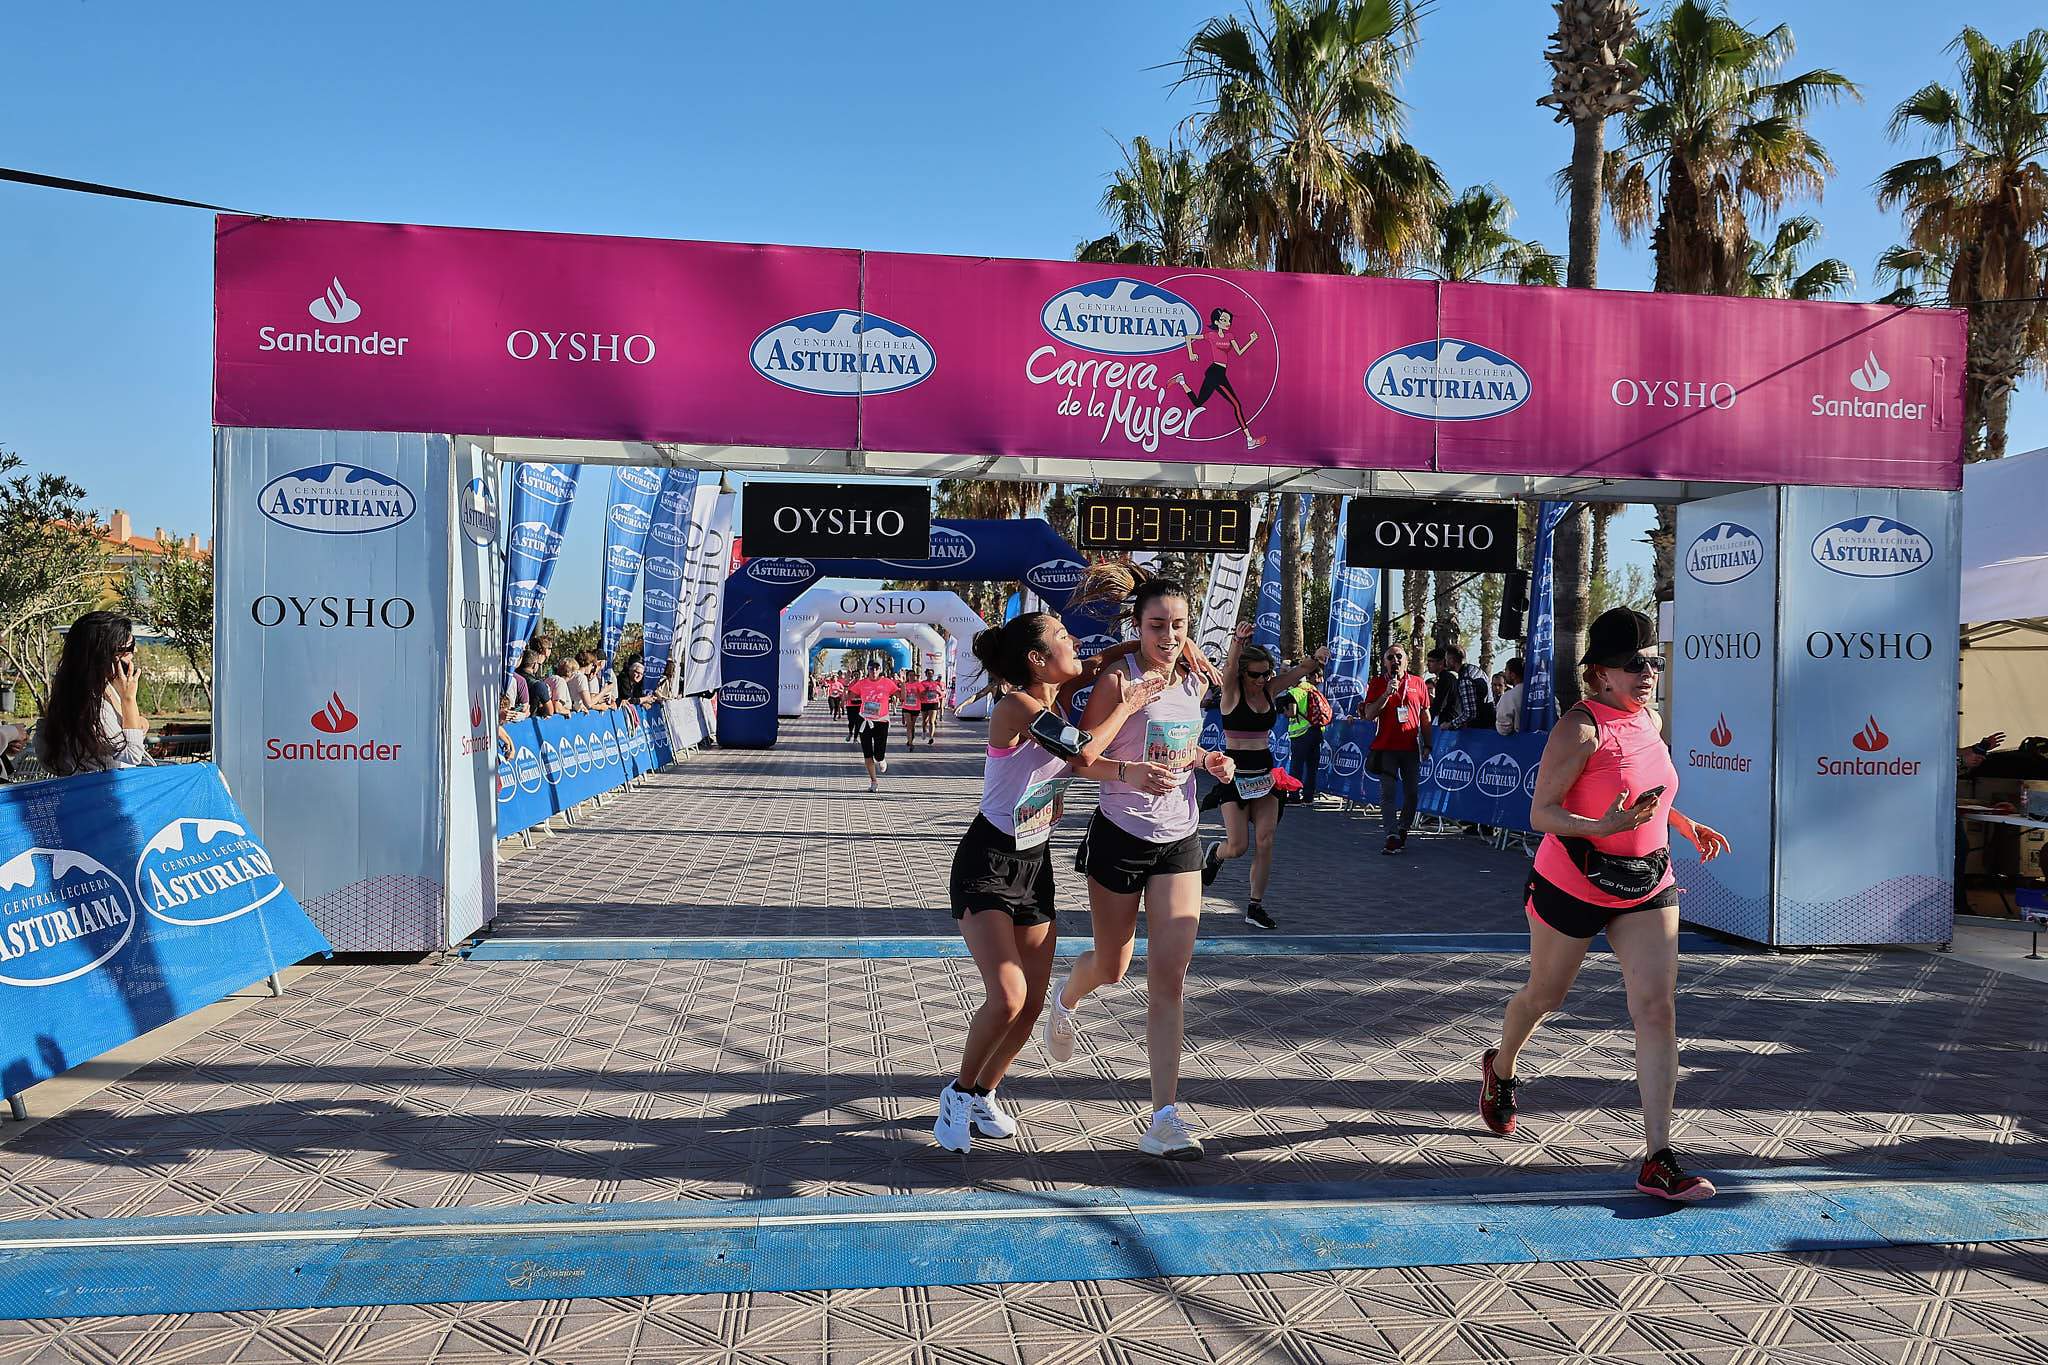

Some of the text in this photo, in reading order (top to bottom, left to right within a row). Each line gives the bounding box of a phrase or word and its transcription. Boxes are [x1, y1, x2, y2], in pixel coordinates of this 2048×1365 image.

[1053, 303, 1189, 338] ASTURIANA
[1078, 302, 1186, 315] CENTRAL LECHERA
[258, 326, 409, 357] Santander
[506, 329, 657, 364] OYSHO
[793, 337, 851, 349] CENTRAL
[764, 338, 922, 375] ASTURIANA
[1025, 345, 1166, 391] Carrera
[1377, 366, 1518, 401] ASTURIANA
[1403, 365, 1514, 377] CENTRAL LECHERA
[1610, 378, 1737, 410] OYSHO
[1811, 394, 1927, 420] Santander
[1057, 388, 1207, 453] de la Mujer
[293, 486, 400, 497] CENTRAL LECHERA
[519, 468, 574, 499] ASTURIANA
[269, 487, 405, 518] ASTURIANA
[773, 506, 905, 537] OYSHO
[1089, 505, 1238, 544] 00:37:12
[1374, 520, 1494, 550] OYSHO
[1819, 538, 1924, 564] ASTURIANA
[1838, 537, 1920, 546] CENTRAL LECHERA
[751, 564, 810, 577] ASTURIANA
[1690, 549, 1757, 573] ASTURIANA
[1032, 571, 1086, 583] ASTURIAN
[250, 595, 416, 629] OYSHO
[460, 598, 496, 632] OYSHO
[839, 596, 925, 615] OYSHO
[722, 638, 769, 651] ASTURIANA
[1684, 631, 1762, 661] OYSHO
[1806, 631, 1933, 661] OYSHO
[720, 689, 767, 702] ASTURIANA
[266, 737, 402, 762] Santander
[1688, 749, 1752, 773] Santander
[1436, 764, 1471, 783] ASTURIANA
[1478, 769, 1517, 788] ASTURIANA
[1816, 756, 1921, 777] Santander
[162, 852, 212, 873] CENTRAL
[3, 877, 111, 916] CENTRAL LECHERA
[148, 853, 275, 912] ASTURIAN
